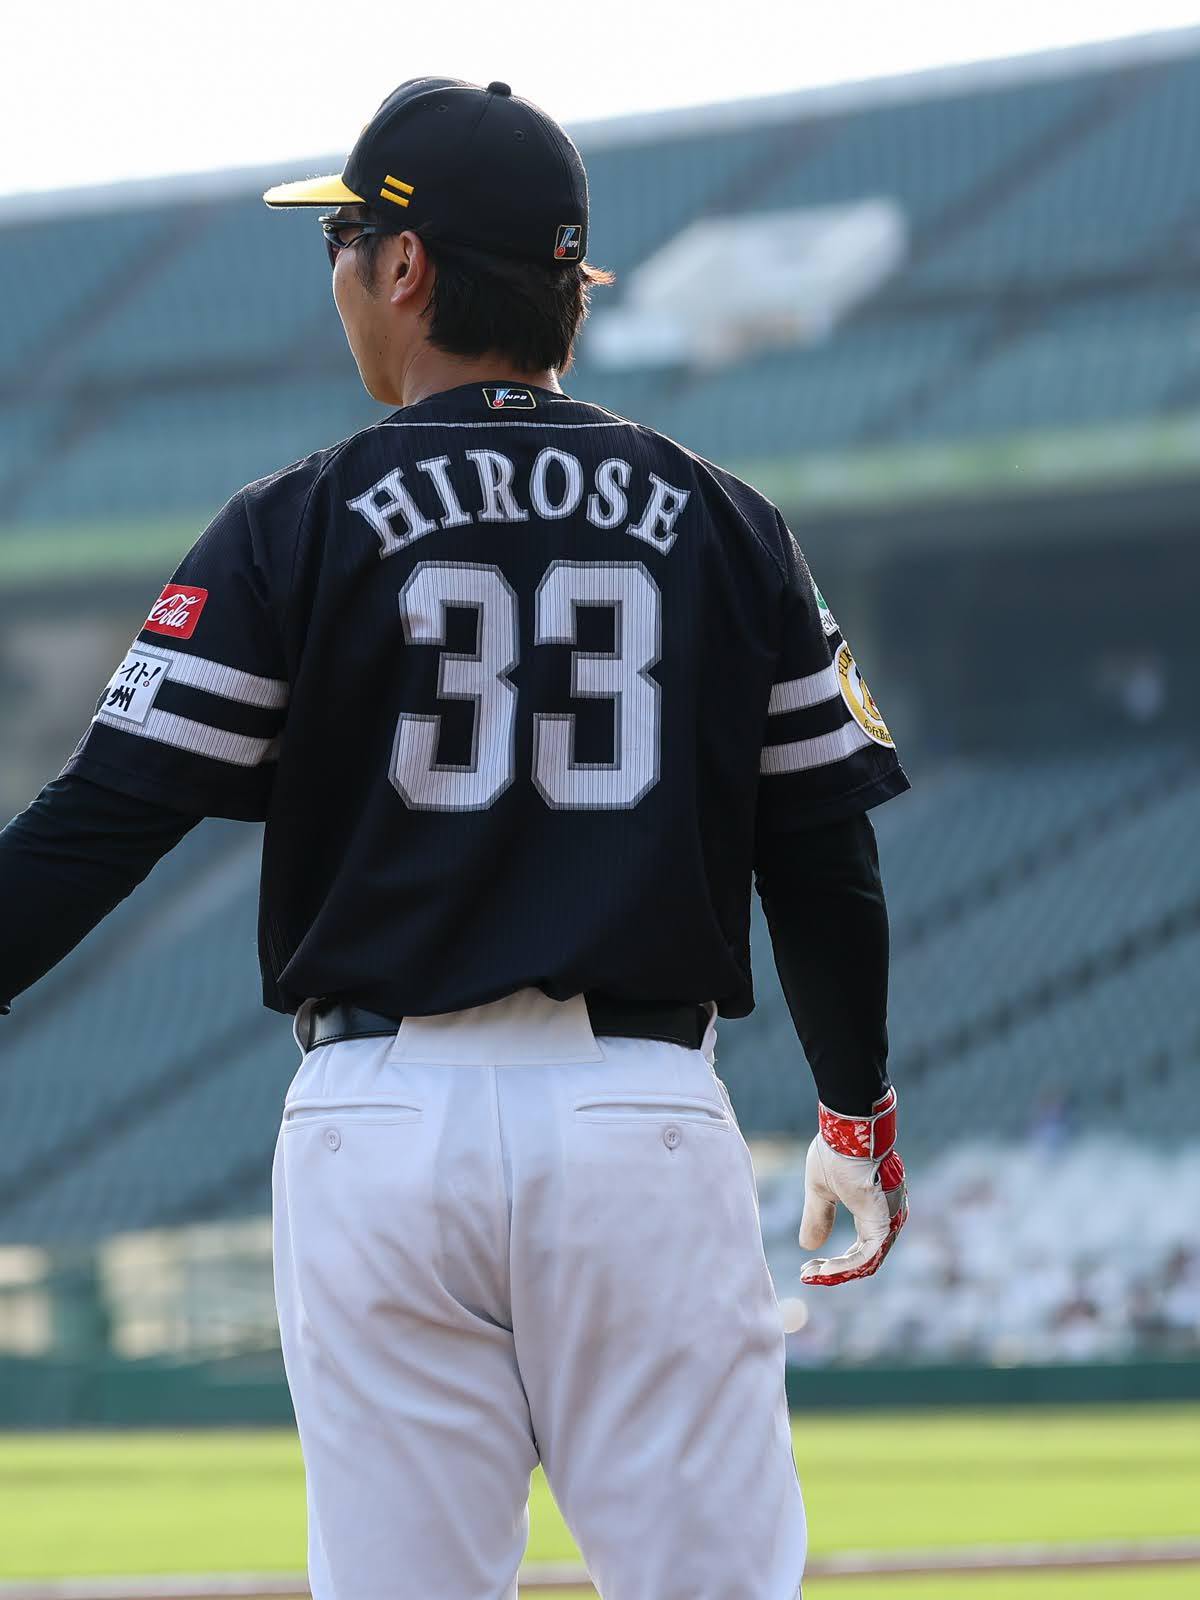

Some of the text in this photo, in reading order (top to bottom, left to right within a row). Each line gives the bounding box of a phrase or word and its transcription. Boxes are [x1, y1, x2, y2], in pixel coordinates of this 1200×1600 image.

[345, 446, 692, 560] HIROSE
[147, 593, 202, 628] Cola
[119, 661, 162, 688] イト!
[387, 559, 663, 813] 33
